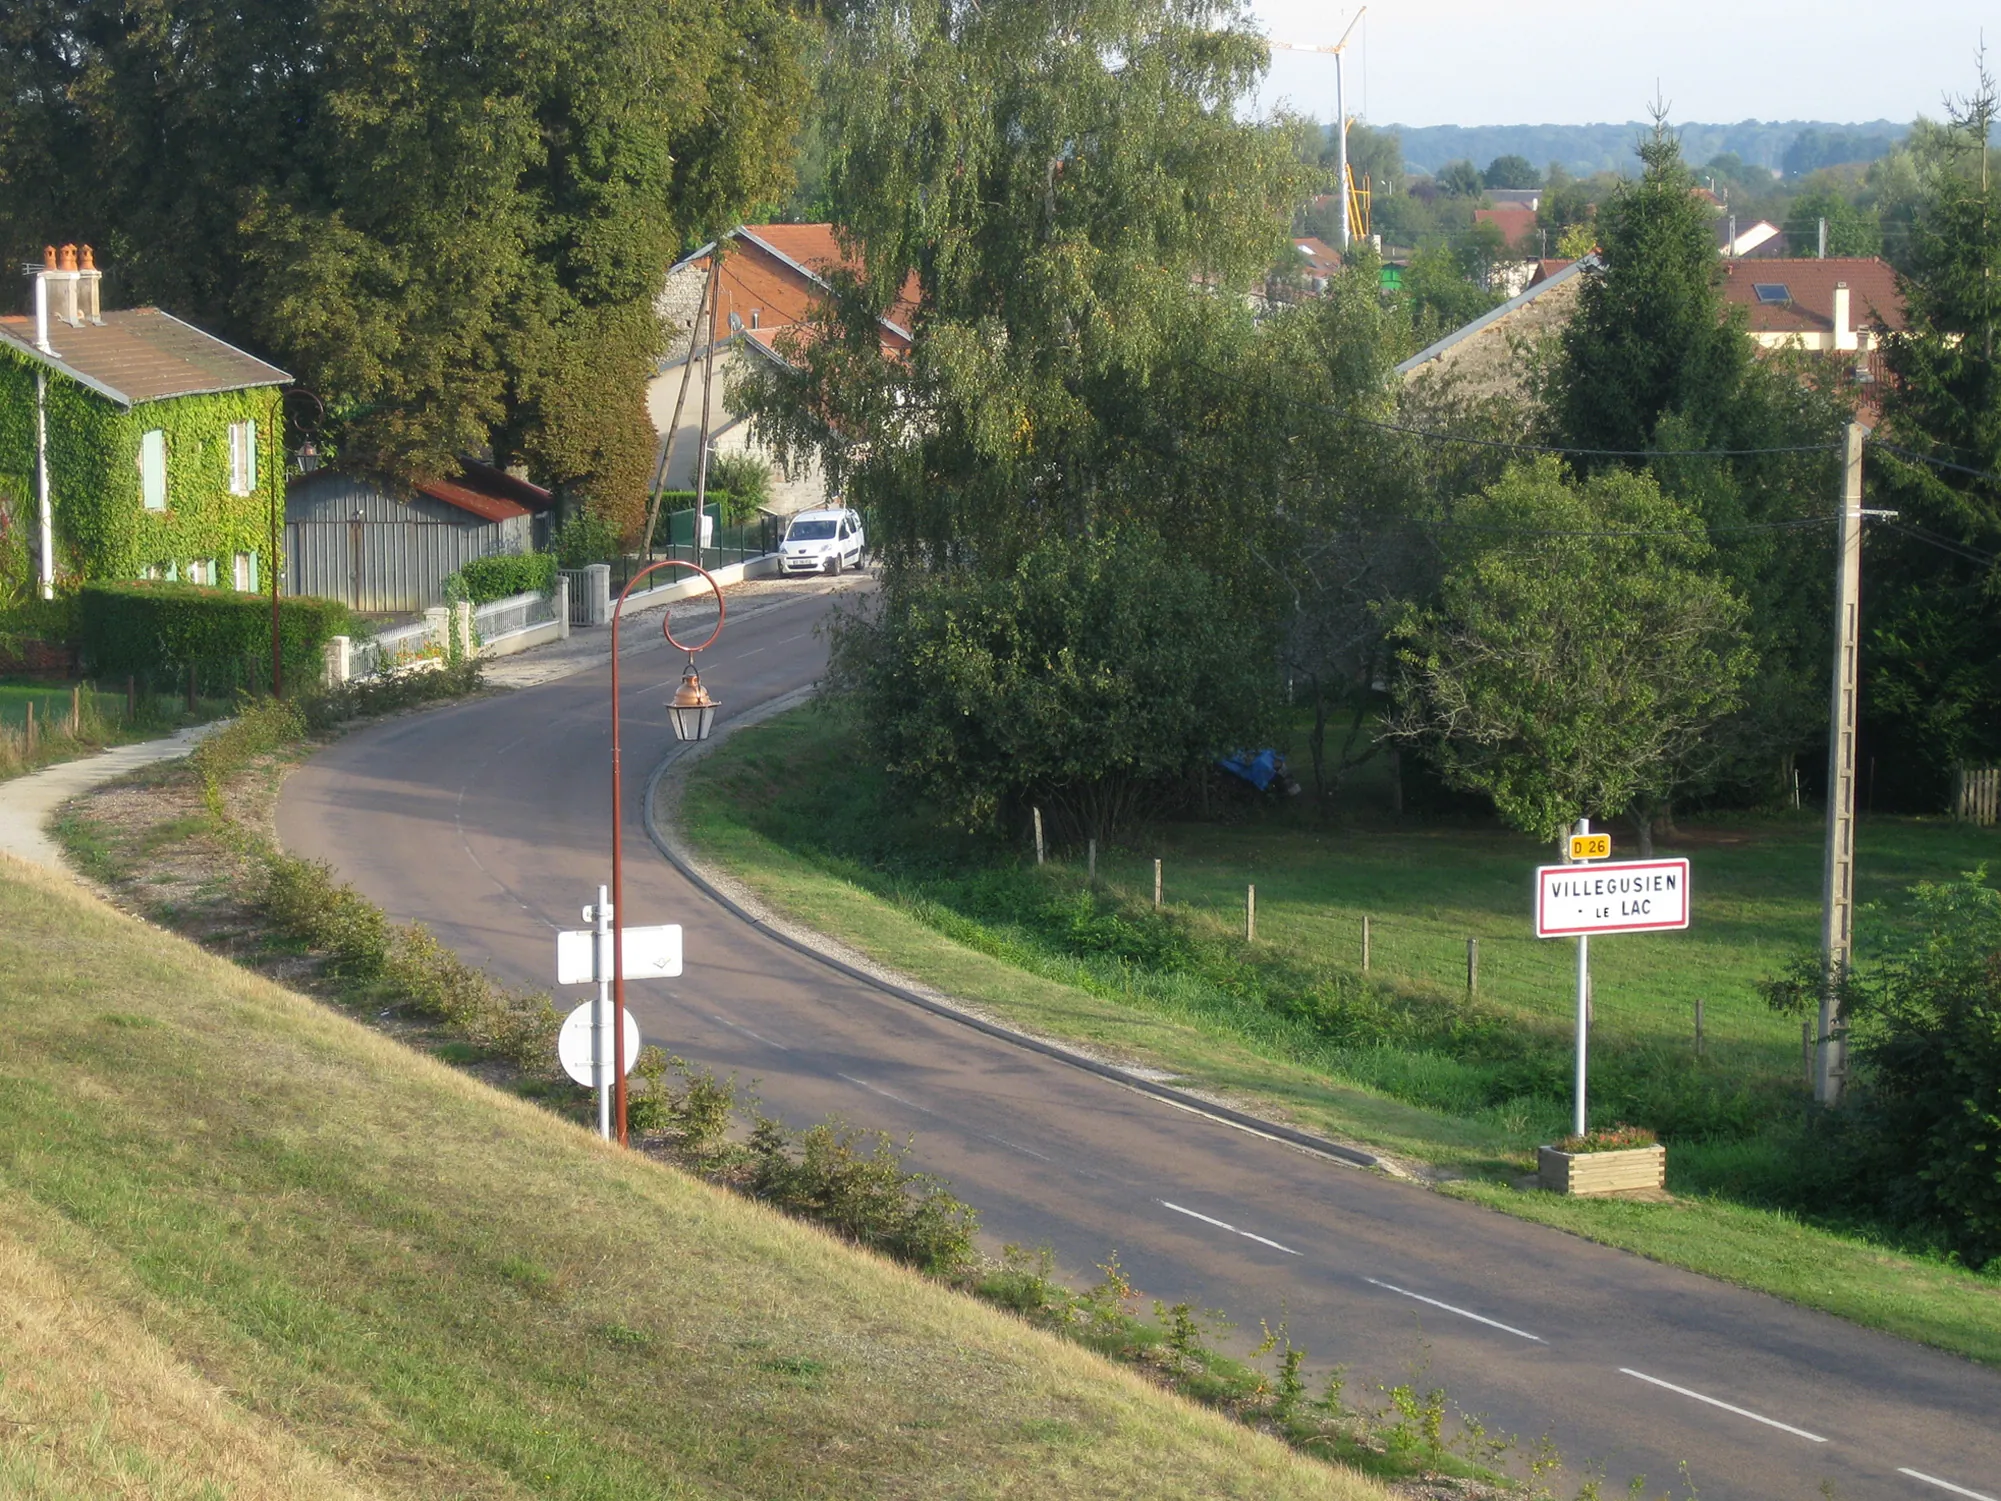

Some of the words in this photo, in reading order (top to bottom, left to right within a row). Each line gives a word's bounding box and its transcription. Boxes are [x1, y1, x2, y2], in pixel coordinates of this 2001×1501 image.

[1574, 841, 1582, 854] D
[1588, 840, 1605, 853] 26
[1552, 875, 1676, 898] VILLEGUSIEN
[1596, 907, 1609, 918] LE
[1622, 899, 1651, 916] LAC
